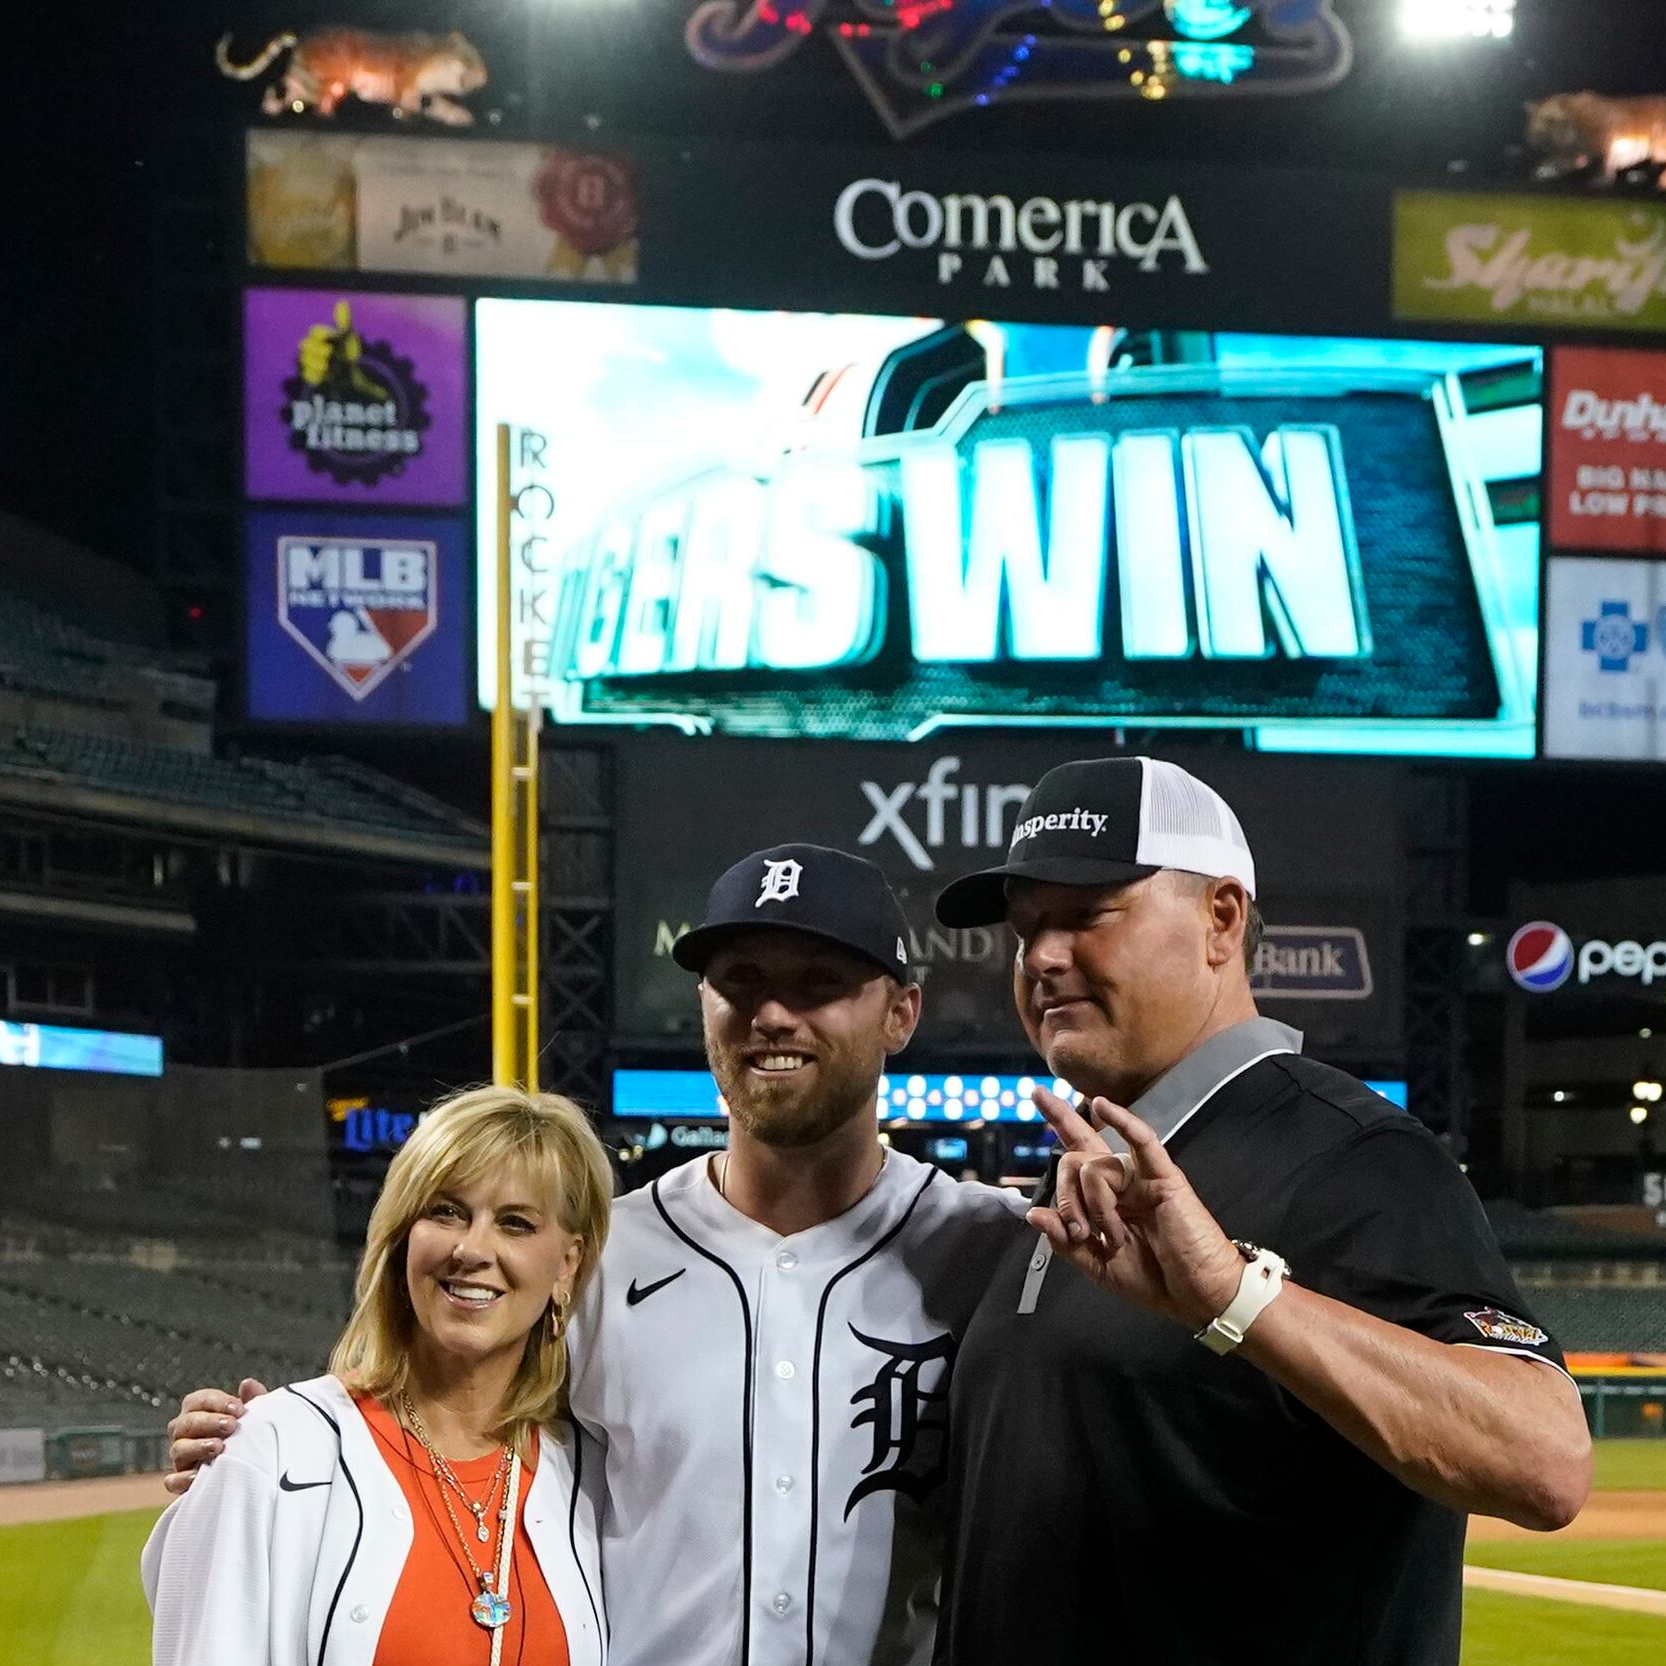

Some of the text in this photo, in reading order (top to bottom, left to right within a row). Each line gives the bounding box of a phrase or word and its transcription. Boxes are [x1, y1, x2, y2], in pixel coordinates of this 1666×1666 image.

[938, 252, 1110, 293] PARK
[291, 394, 397, 431] planet
[305, 423, 420, 453] fitness
[1569, 490, 1630, 517] LOW
[899, 425, 1373, 662] WIN
[289, 547, 426, 591] MLB
